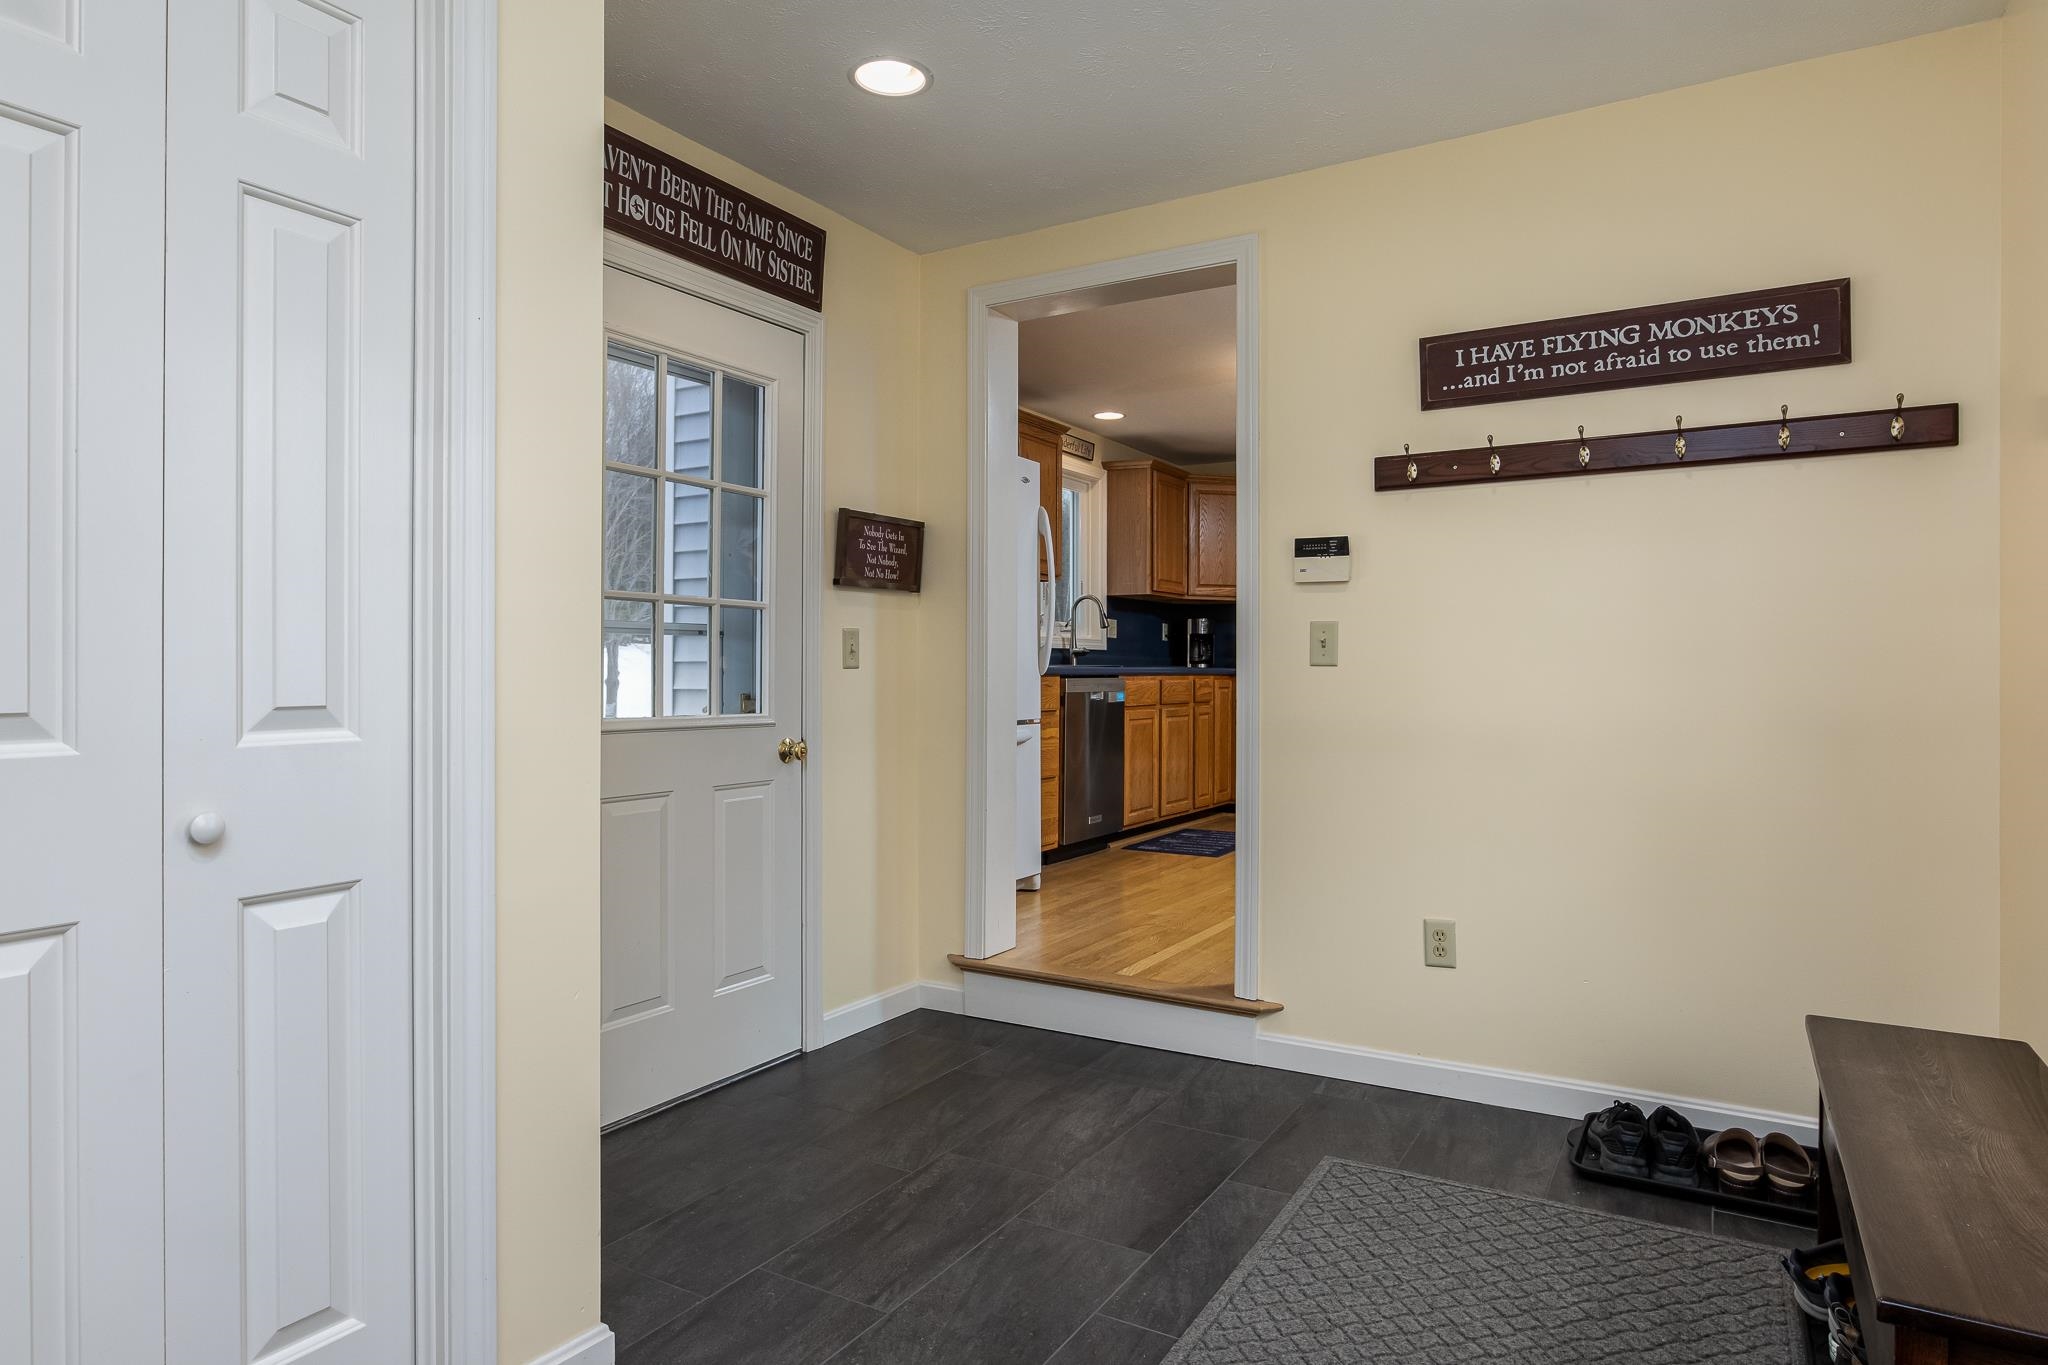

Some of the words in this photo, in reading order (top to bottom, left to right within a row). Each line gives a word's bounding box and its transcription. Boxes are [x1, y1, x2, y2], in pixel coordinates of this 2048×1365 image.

[604, 143, 657, 190] VEN'T
[659, 164, 701, 212] BEEN
[704, 185, 734, 225] THE
[736, 202, 774, 244] SAME
[776, 221, 813, 262] SINCE
[679, 210, 717, 253] FELL
[720, 229, 742, 263] ON
[744, 240, 766, 273] MY
[767, 250, 815, 295] SISTER.
[1442, 368, 1500, 391] ...and
[1506, 361, 1545, 383] I'm
[1551, 359, 1587, 378] not
[1594, 347, 1661, 373] afraid
[1669, 345, 1692, 362] to
[1699, 341, 1739, 359] use
[1746, 323, 1822, 354] them!
[1455, 349, 1465, 368] I
[1470, 339, 1536, 366] HAVE
[1541, 324, 1641, 356] FLYING
[1648, 303, 1799, 342] MONKEYS
[859, 538, 866, 549] To
[866, 539, 876, 551] See
[877, 541, 888, 552] The
[864, 525, 885, 541] Nobody
[885, 528, 898, 541] Gets
[898, 530, 905, 541] In
[876, 567, 884, 579] No
